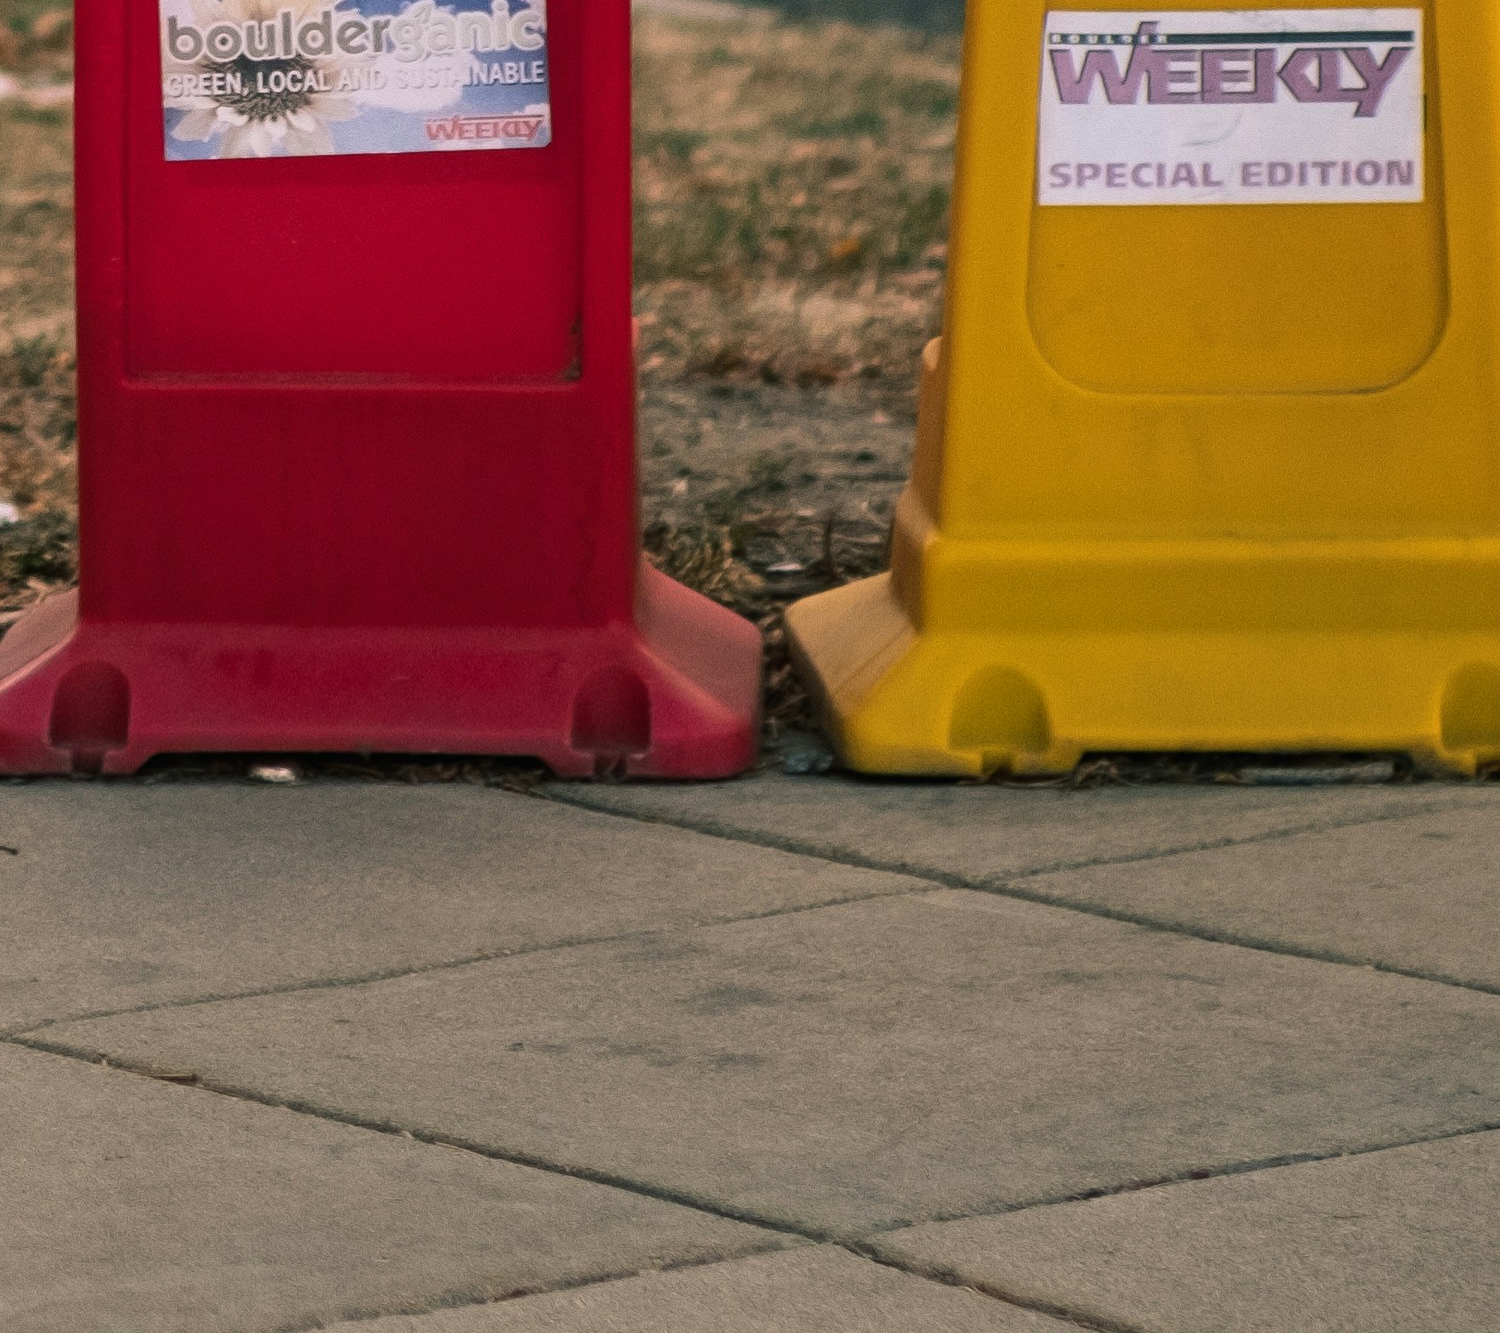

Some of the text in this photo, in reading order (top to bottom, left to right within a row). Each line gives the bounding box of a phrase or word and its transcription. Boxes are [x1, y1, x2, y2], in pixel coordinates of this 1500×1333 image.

[166, 71, 250, 97] GREEN,
[256, 69, 333, 94] LOCAL
[337, 67, 387, 92] AND
[1049, 21, 1413, 118] WEEKLY
[425, 115, 545, 141] WEEKLY
[1048, 159, 1415, 190] SPECIAL EDITION
